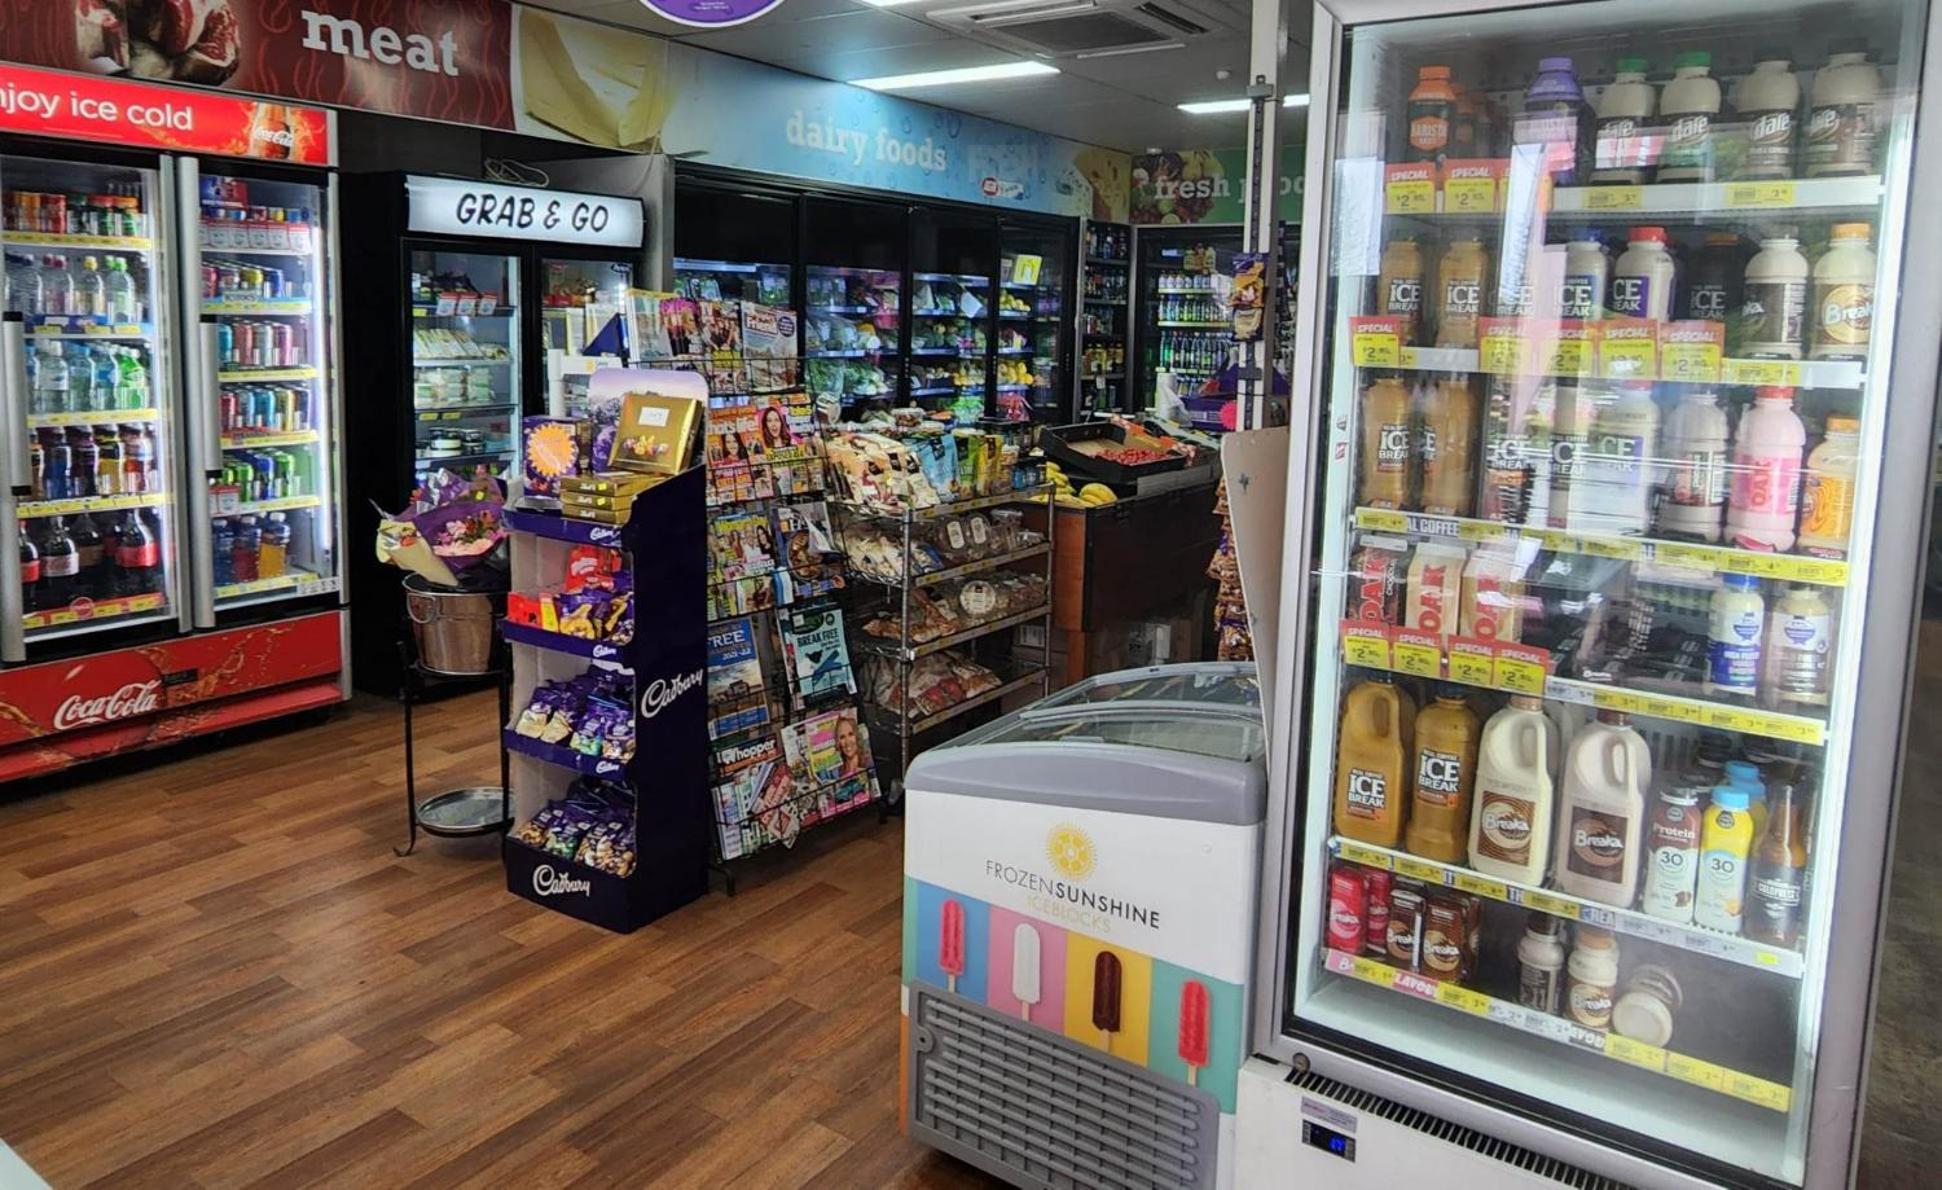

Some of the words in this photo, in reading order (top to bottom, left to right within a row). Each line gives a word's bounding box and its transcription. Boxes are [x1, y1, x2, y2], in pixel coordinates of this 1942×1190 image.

[302, 10, 459, 77] meat
[70, 91, 118, 121] ice
[127, 103, 193, 131] cold
[787, 111, 869, 166] dairy
[876, 127, 946, 171] foods
[1154, 173, 1231, 200] fresh
[456, 193, 533, 229] GRAB
[543, 200, 560, 229] &
[571, 202, 609, 232] GO
[1390, 284, 1422, 303] ICE
[1447, 285, 1480, 304] ICE
[1613, 279, 1642, 300] CE
[1614, 301, 1641, 311] EAK
[1823, 302, 1873, 325] Break
[1381, 430, 1411, 450] ICE
[1598, 436, 1636, 459] CE
[1752, 459, 1771, 507] OAK
[1420, 519, 1458, 537] COFFEE
[1359, 553, 1388, 622] OAK
[1418, 565, 1447, 633] OAK
[796, 633, 822, 647] BREAK
[822, 628, 839, 642] FREE
[54, 679, 162, 730] Coca-Cola
[641, 669, 704, 718] Cadbury
[1420, 755, 1461, 783] ICE
[1349, 775, 1386, 799] ICE
[1418, 775, 1459, 793] BREAK
[1348, 792, 1385, 809] BREAK
[1485, 814, 1530, 832] Breaka
[1653, 822, 1696, 840] Protein
[1574, 829, 1624, 849] Breaka
[1661, 851, 1684, 867] 30
[1711, 858, 1735, 873] 30
[533, 864, 591, 897] Cadbury
[986, 860, 1161, 930] FROZENSUNSHINE
[1395, 972, 1437, 997] LAVOU
